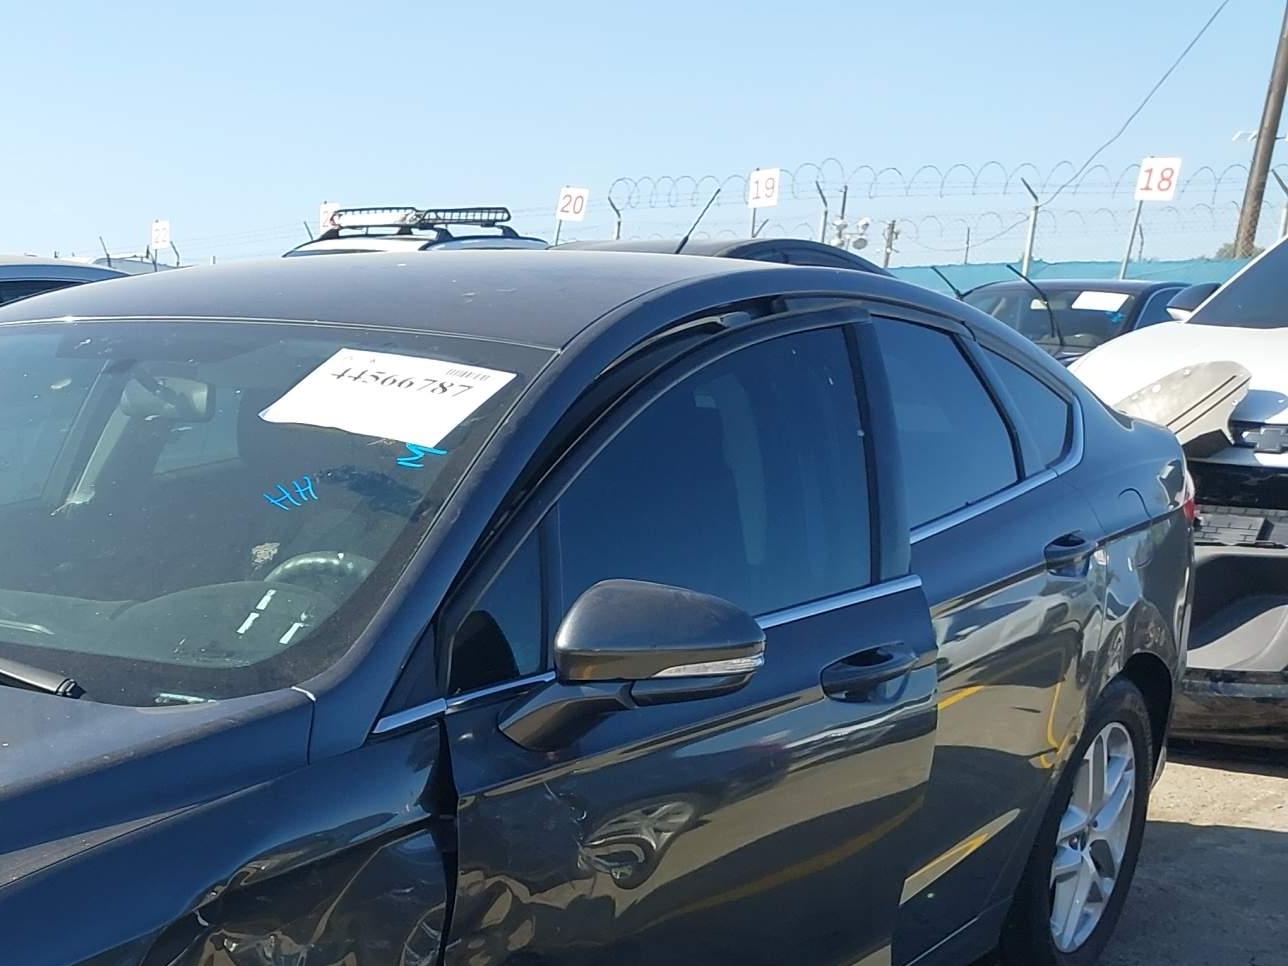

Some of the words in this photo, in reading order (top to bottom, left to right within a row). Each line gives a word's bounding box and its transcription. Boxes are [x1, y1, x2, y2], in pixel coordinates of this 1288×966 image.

[752, 177, 775, 200] 19
[1139, 167, 1175, 192] 18
[559, 194, 584, 215] 20
[331, 368, 473, 397] 44566787
